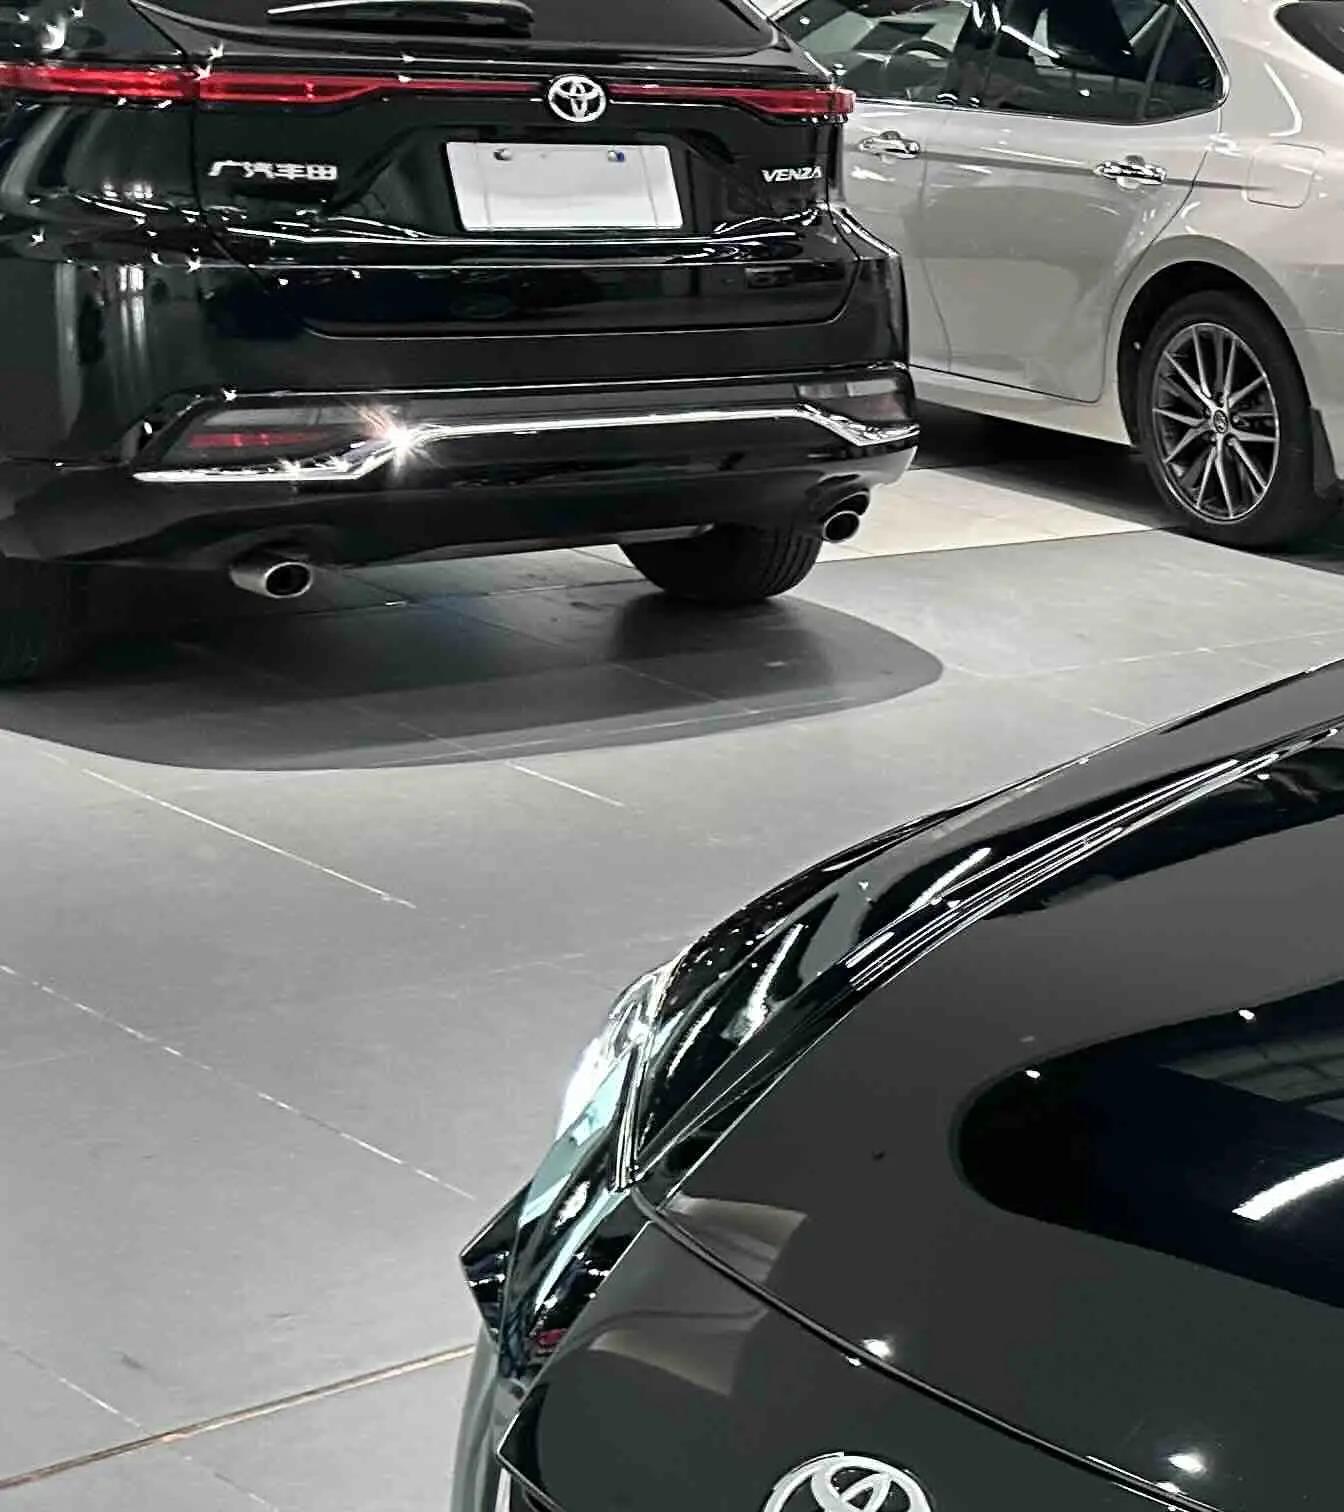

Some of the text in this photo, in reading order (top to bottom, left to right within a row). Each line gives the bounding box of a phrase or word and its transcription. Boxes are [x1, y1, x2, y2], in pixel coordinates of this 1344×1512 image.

[208, 160, 338, 180] 广汽丰田
[761, 165, 822, 182] VENZA
